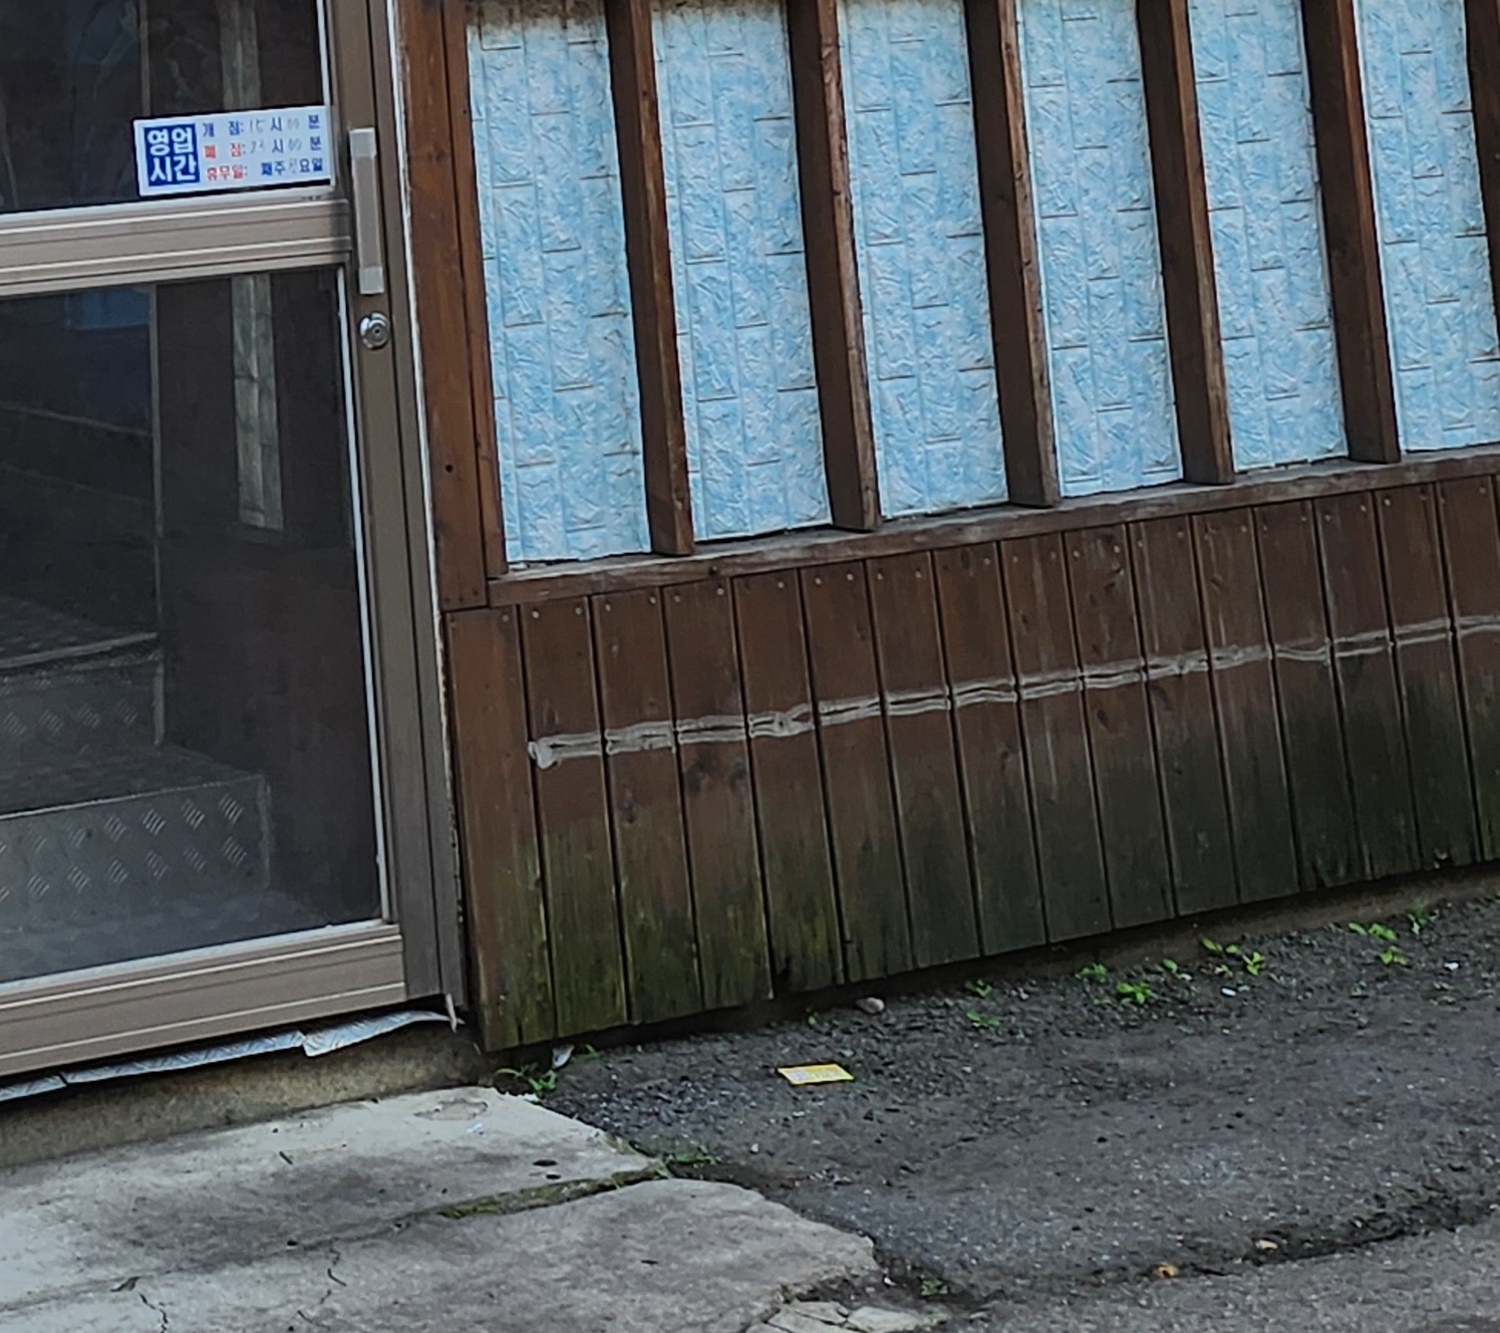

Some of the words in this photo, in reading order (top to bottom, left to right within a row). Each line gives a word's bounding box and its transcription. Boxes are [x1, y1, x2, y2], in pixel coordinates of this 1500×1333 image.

[202, 122, 215, 137] 개
[270, 116, 283, 132] 시
[308, 114, 321, 130] 분
[146, 126, 195, 156] 영업
[272, 138, 284, 154] 시
[309, 135, 322, 152] 분
[150, 154, 197, 183] 시간
